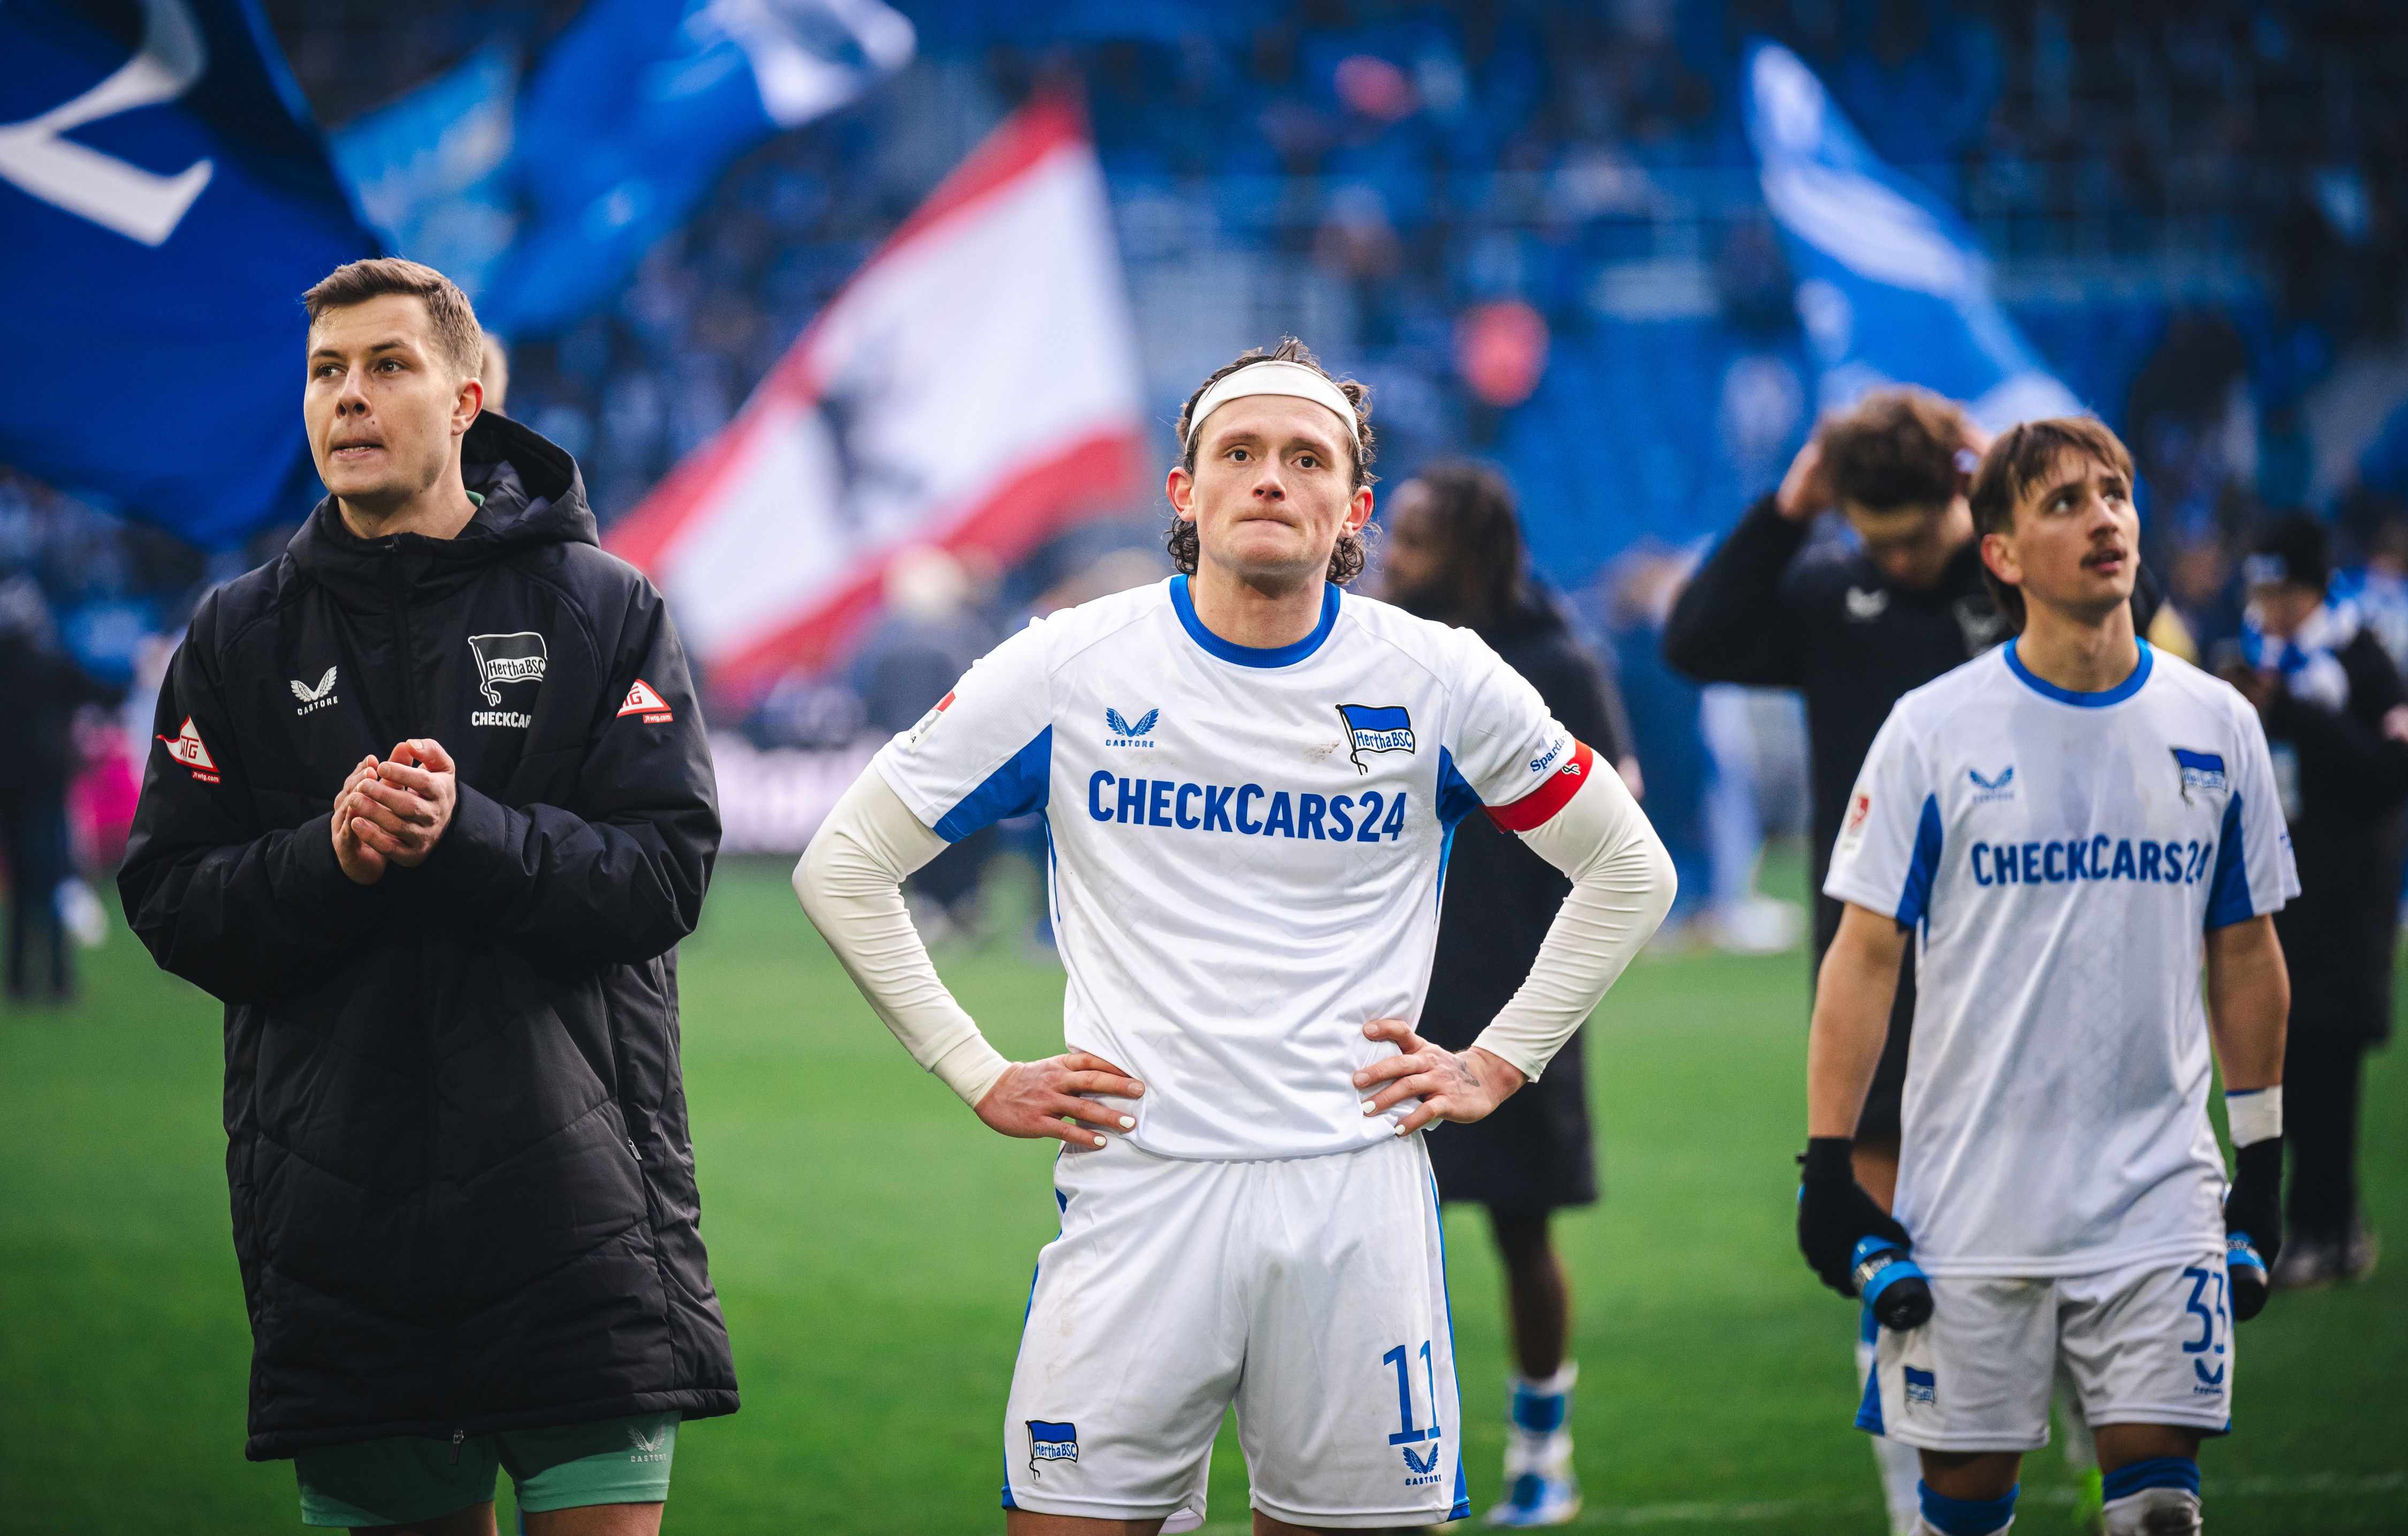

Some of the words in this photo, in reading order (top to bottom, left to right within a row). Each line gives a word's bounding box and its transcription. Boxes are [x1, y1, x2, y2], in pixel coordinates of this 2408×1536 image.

[297, 696, 338, 716] CASTORE
[1106, 739, 1154, 748] CASTORE
[1088, 770, 1406, 842] CHECKCARS24
[1383, 1340, 1441, 1446] 11
